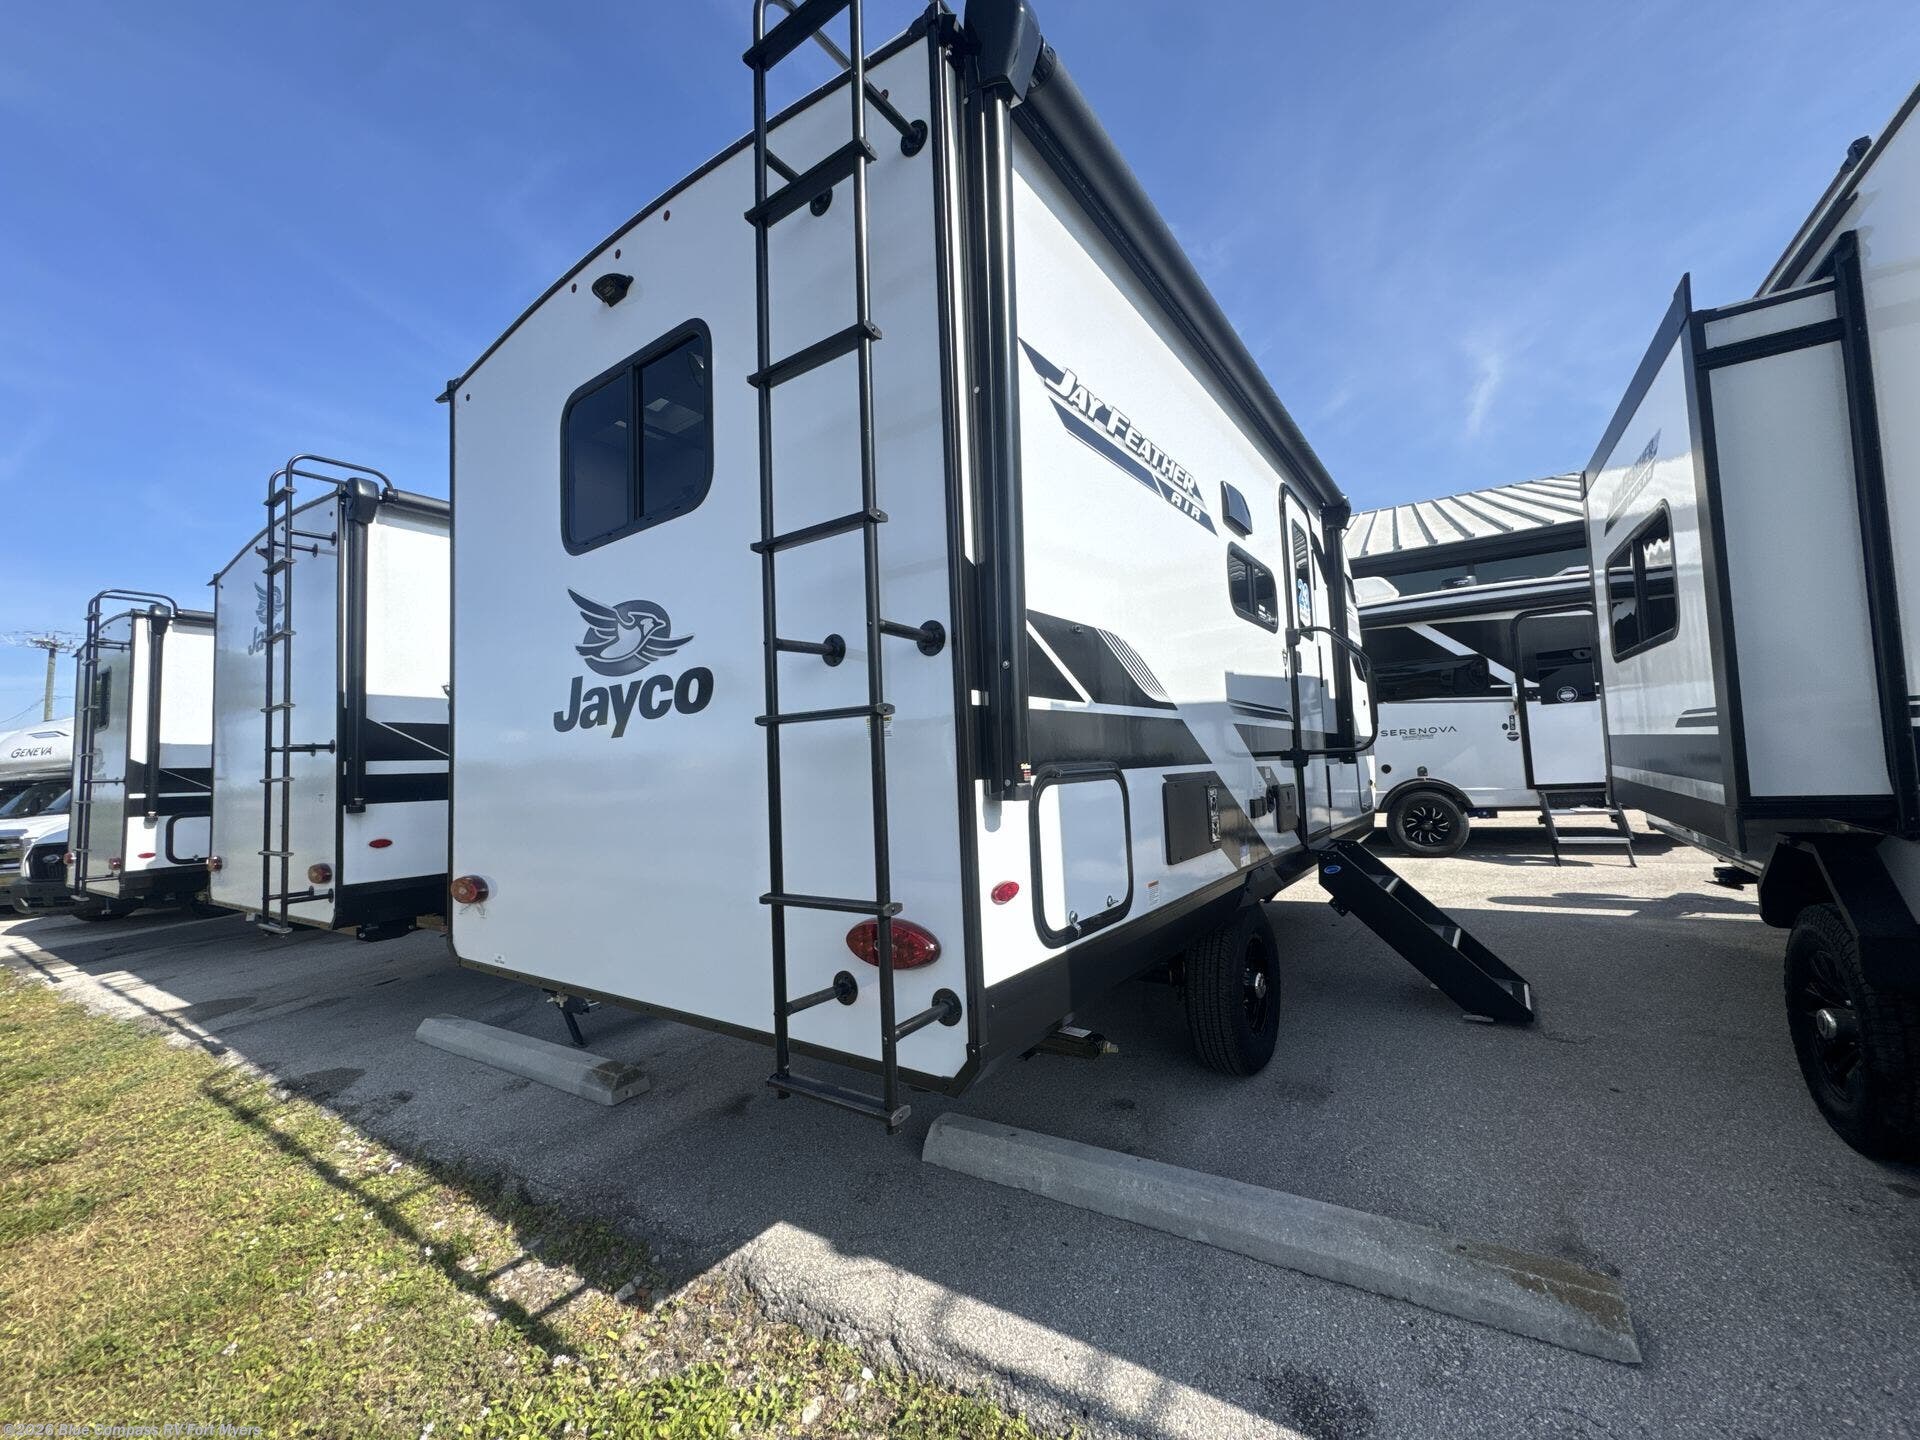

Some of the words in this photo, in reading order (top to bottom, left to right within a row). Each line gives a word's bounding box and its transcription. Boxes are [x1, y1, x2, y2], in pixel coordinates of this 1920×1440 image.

[1043, 367, 1104, 423] JAY
[1106, 405, 1198, 499] FEATHER
[1170, 491, 1201, 522] AIR
[553, 666, 714, 738] Jayco
[1380, 726, 1458, 737] SERENOVA
[11, 746, 53, 758] GENEVA
